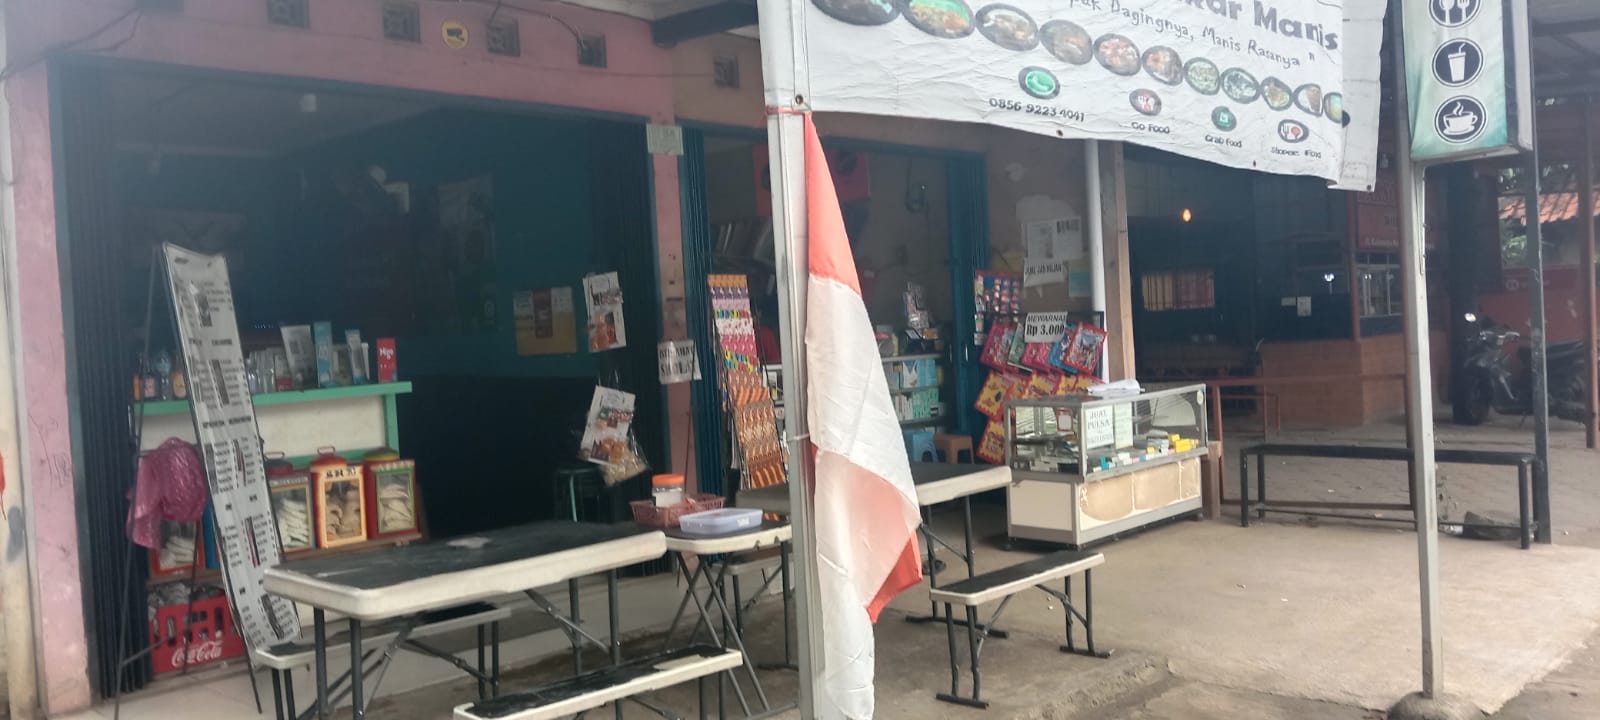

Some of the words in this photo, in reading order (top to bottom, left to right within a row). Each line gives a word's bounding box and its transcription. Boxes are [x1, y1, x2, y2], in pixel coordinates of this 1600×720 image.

[1254, 0, 1339, 50] Manis
[1202, 26, 1241, 51] Manis
[1248, 40, 1301, 69] Rasanya
[989, 97, 1022, 112] 0856
[1025, 103, 1057, 117] 9223
[1059, 110, 1085, 122] 4041
[1026, 324, 1038, 336] Rp
[1040, 324, 1065, 335] 3.000
